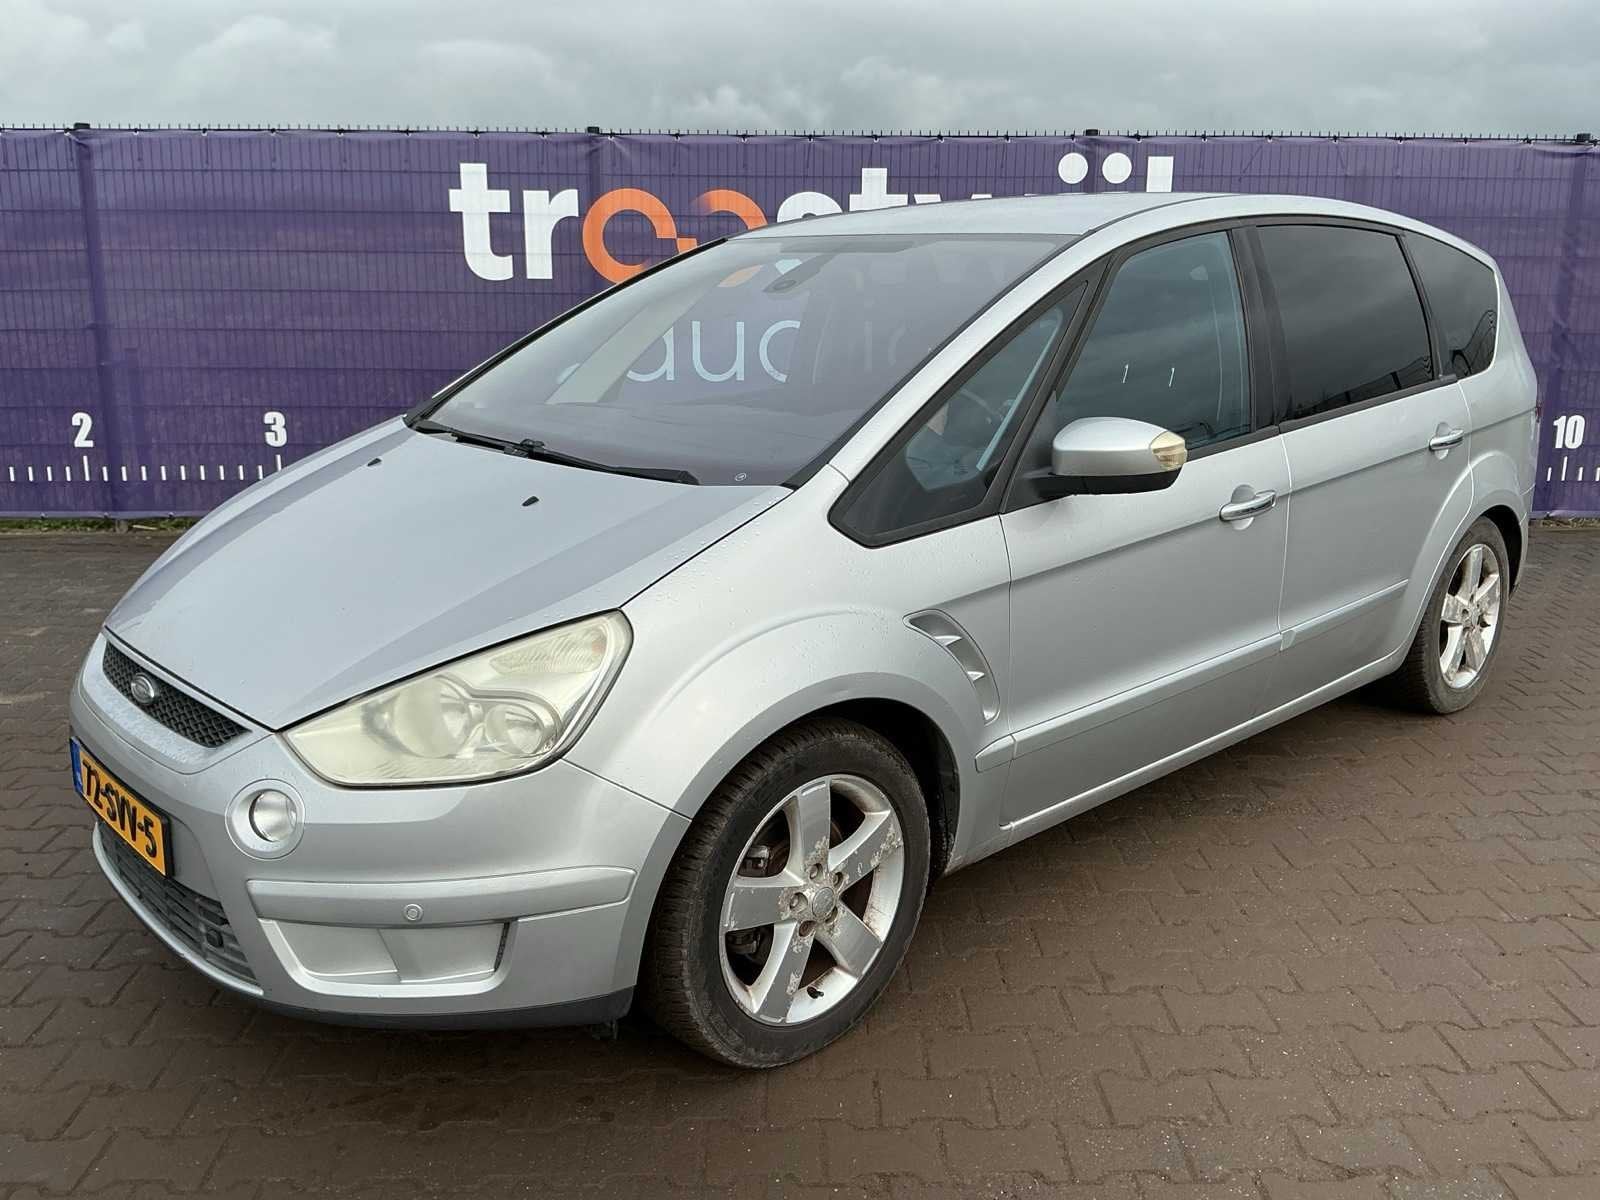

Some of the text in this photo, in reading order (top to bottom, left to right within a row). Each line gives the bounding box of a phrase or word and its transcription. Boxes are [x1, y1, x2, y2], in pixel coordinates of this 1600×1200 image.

[71, 412, 94, 448] 2
[263, 411, 287, 448] 3
[1553, 414, 1586, 449] 10
